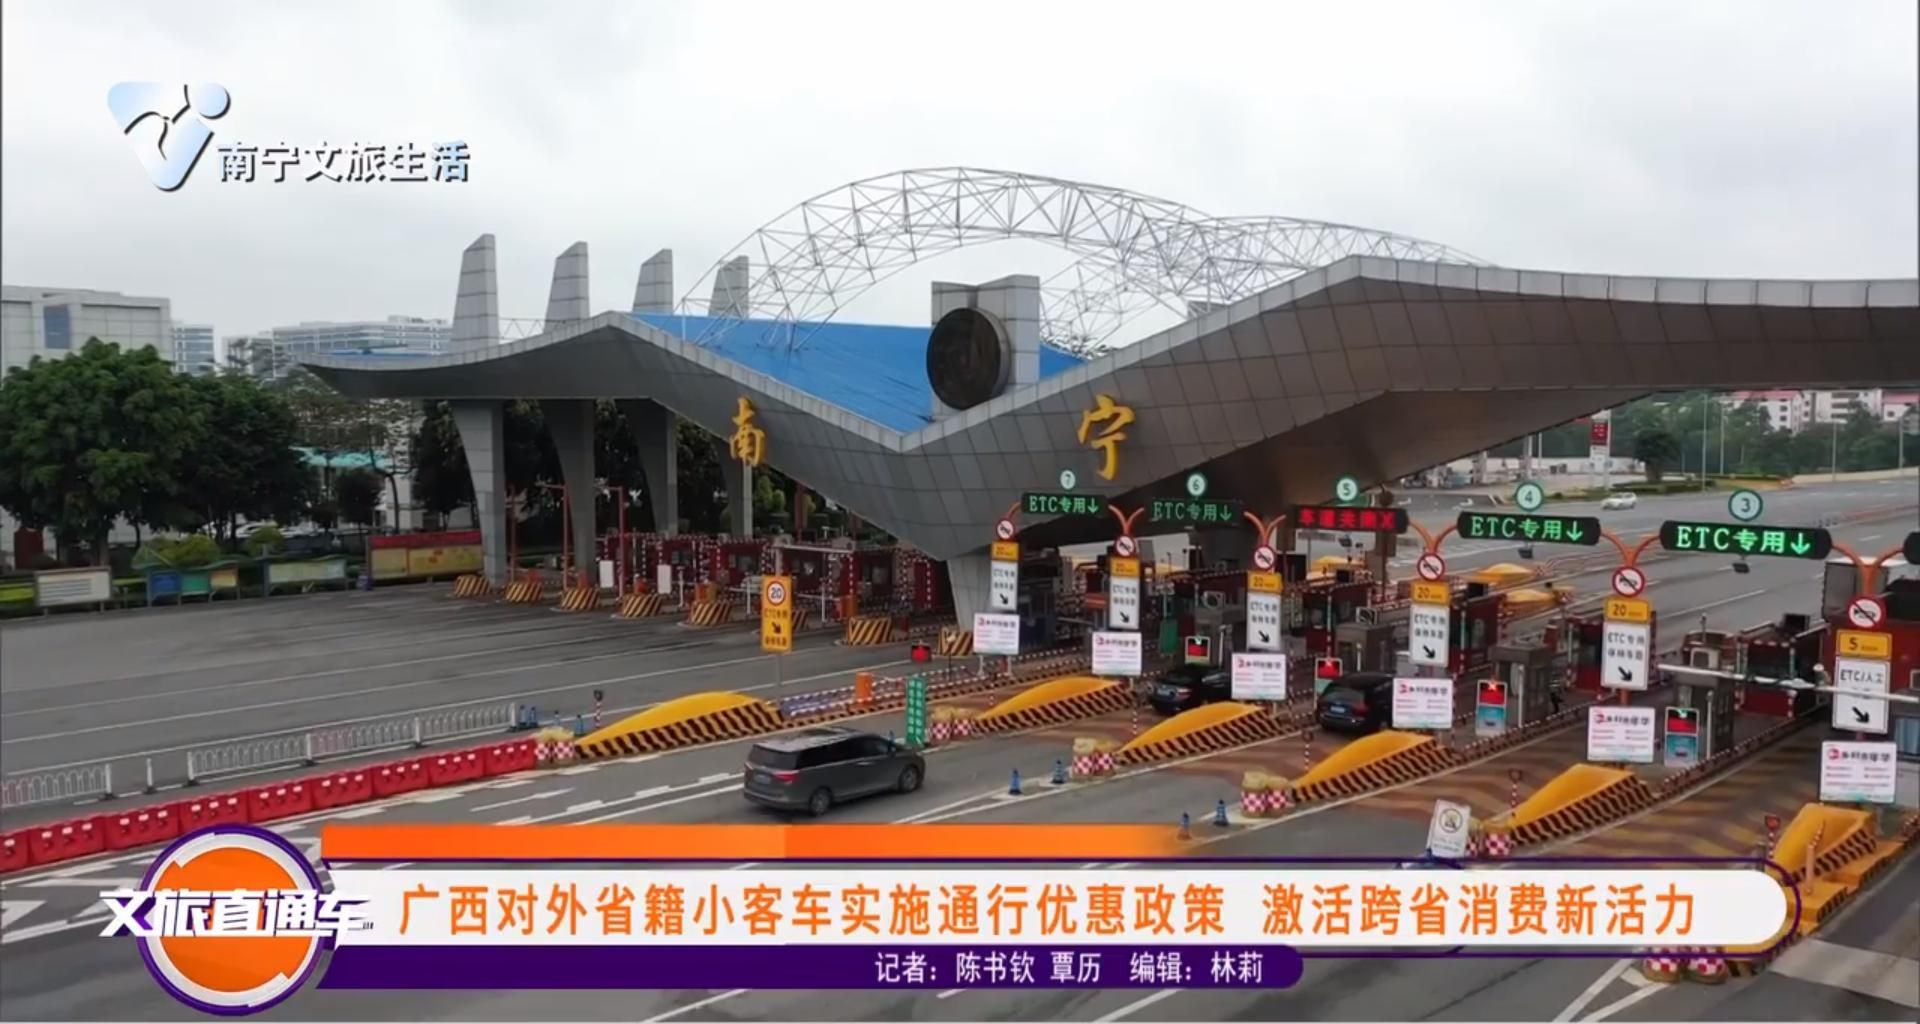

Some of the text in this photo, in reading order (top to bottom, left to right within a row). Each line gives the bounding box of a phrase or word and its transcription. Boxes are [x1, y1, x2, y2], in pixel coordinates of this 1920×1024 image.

[728, 393, 1137, 480] 南 宁
[1028, 495, 1087, 514] ETC专用
[1525, 490, 1533, 504] 4
[1741, 497, 1751, 513] 3
[1152, 501, 1217, 522] ETC专用
[1471, 516, 1563, 540] ETC专用
[1676, 525, 1785, 553] ETC专用
[771, 587, 783, 600] 20
[1417, 587, 1430, 600] 20
[1612, 604, 1627, 617] 20
[1848, 636, 1858, 651] 5
[1840, 668, 1884, 685] ETC/人工
